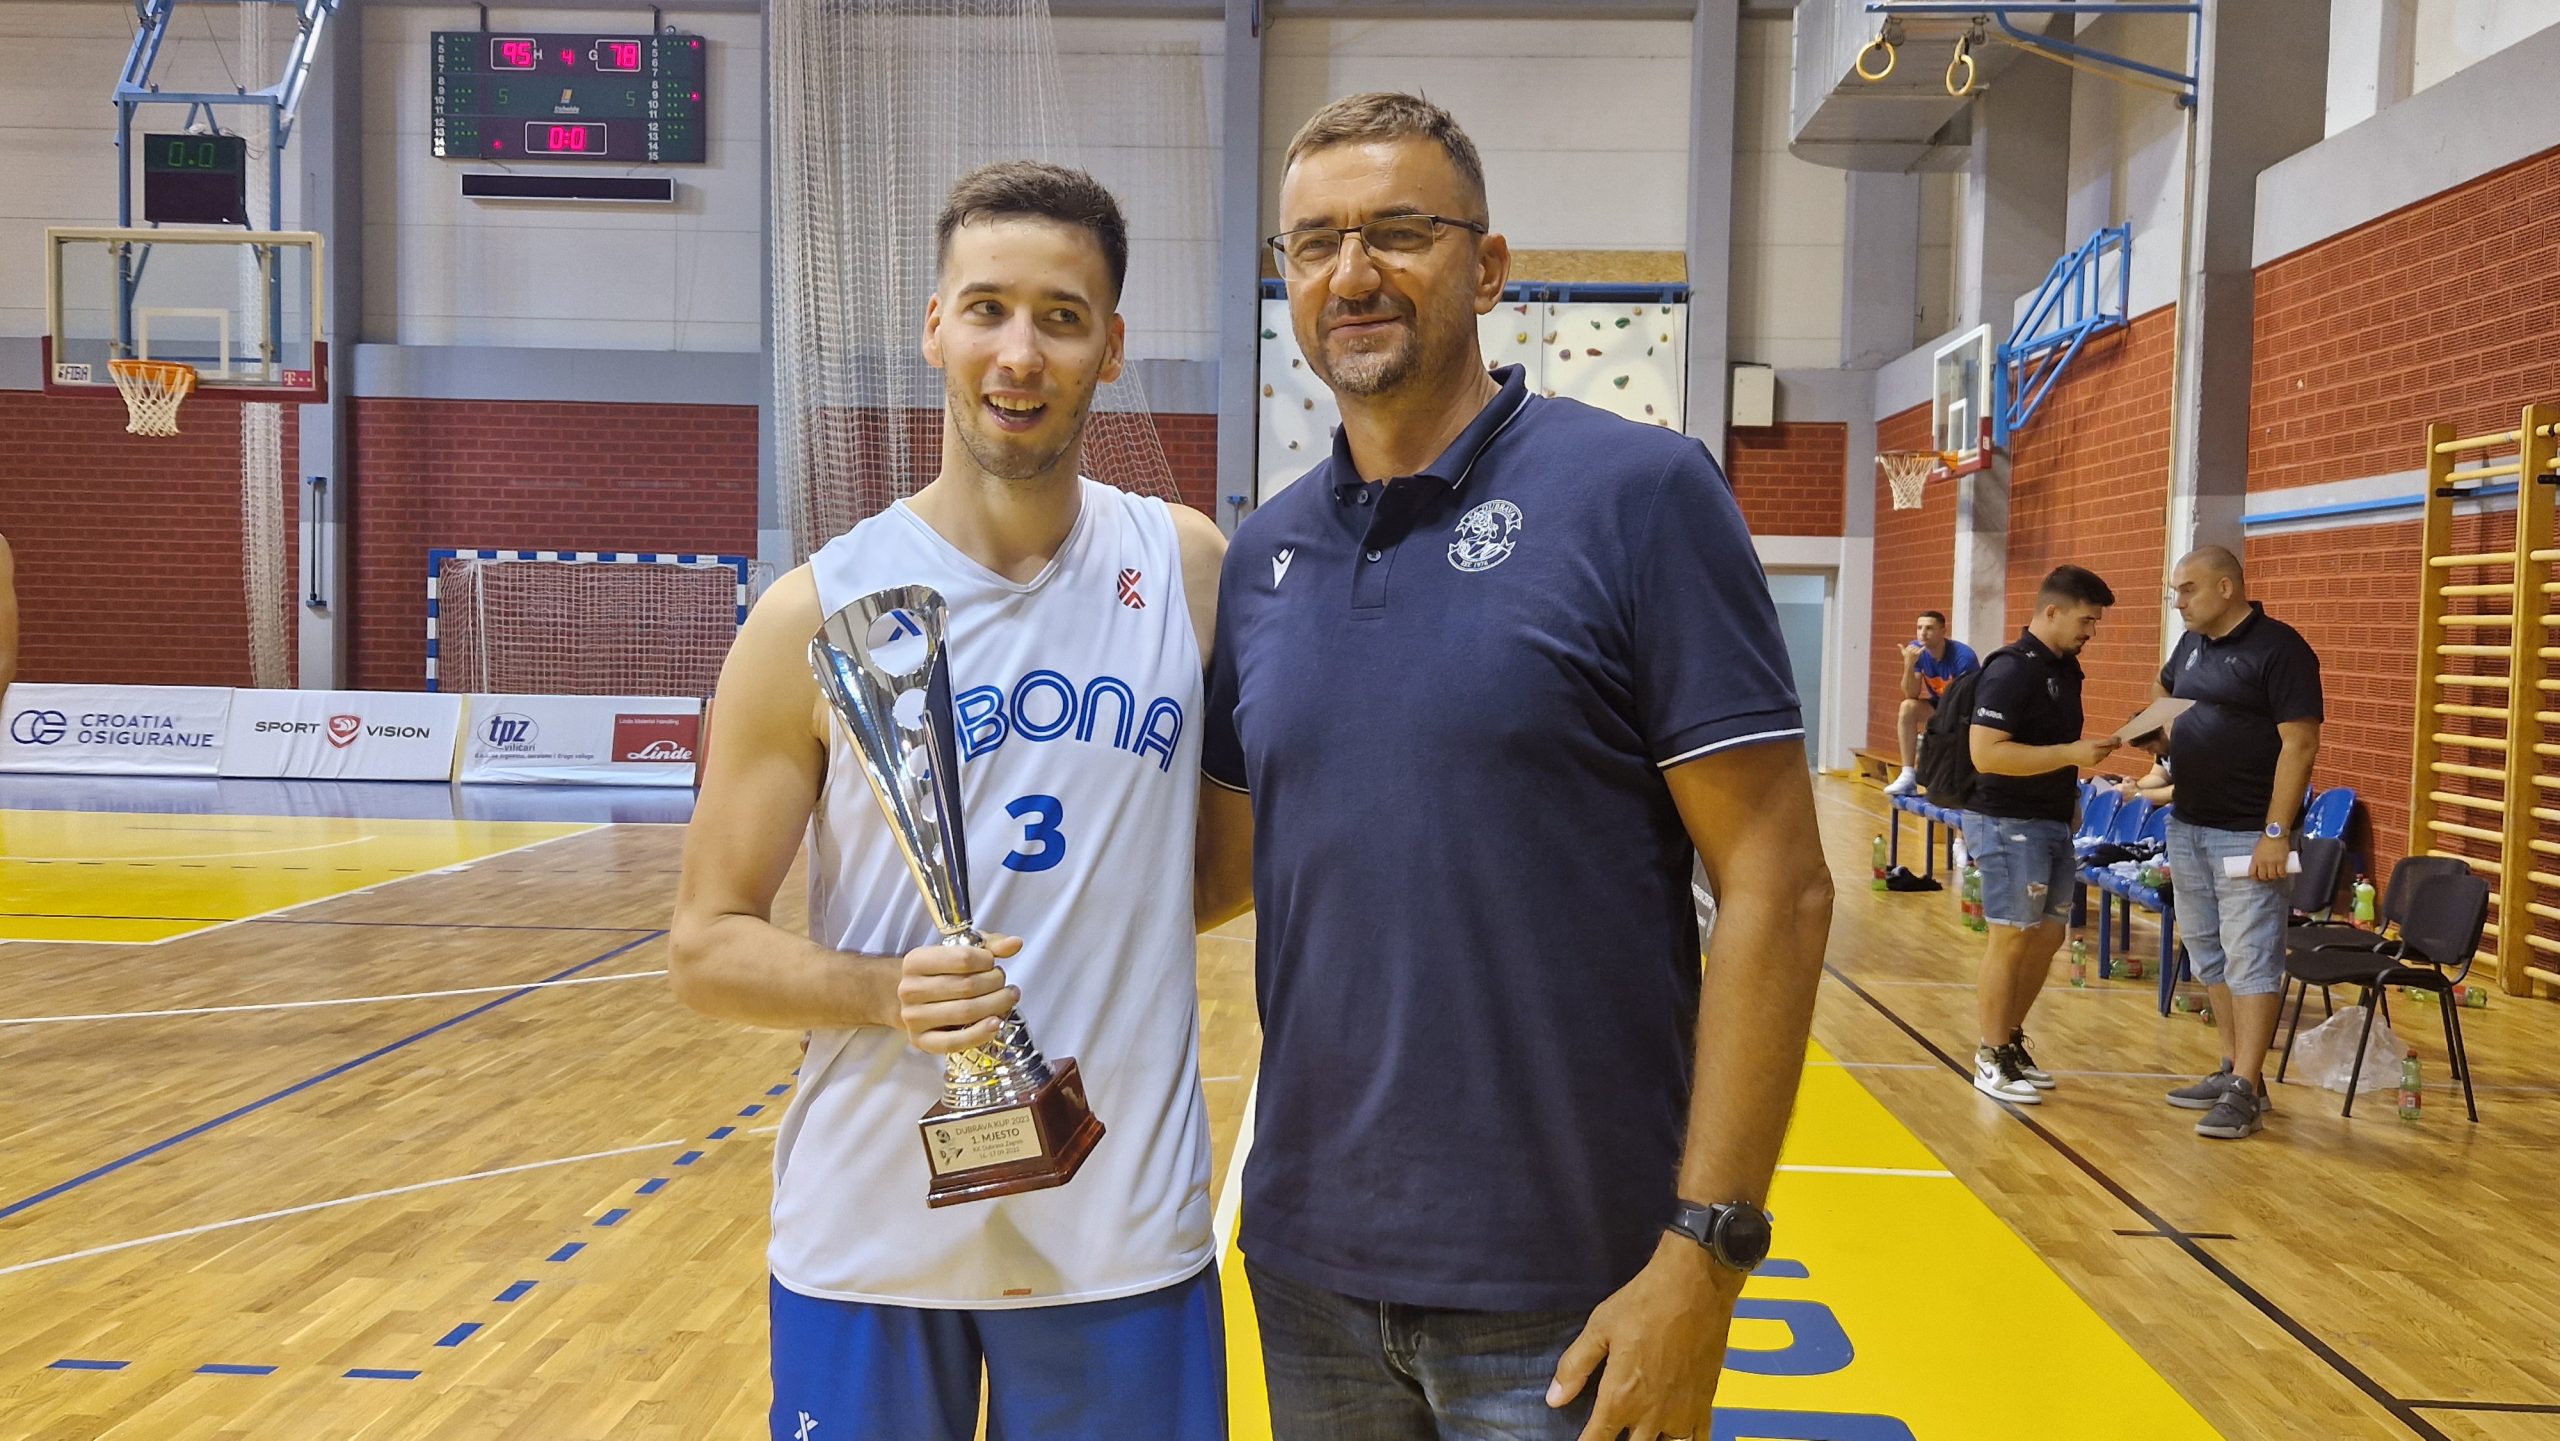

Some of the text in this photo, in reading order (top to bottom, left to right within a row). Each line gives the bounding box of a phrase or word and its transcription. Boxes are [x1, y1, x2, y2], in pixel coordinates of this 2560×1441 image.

[438, 35, 445, 43] 4
[651, 38, 659, 47] 4
[438, 45, 445, 53] 5
[651, 48, 659, 57] 5
[438, 54, 445, 63] 6
[502, 42, 532, 66] 95
[562, 49, 575, 65] 4
[588, 49, 598, 61] G
[609, 43, 637, 68] 78
[651, 58, 659, 67] 6
[438, 64, 445, 73] 7
[651, 68, 659, 77] 7
[438, 76, 445, 85] 8
[651, 80, 659, 90] 8
[438, 86, 445, 95] 9
[651, 90, 659, 99] 9
[434, 96, 445, 105] 10
[648, 100, 659, 109] 10
[434, 106, 445, 114] 11
[648, 110, 659, 119] 11
[434, 117, 445, 127] 12
[648, 122, 659, 131] 12
[434, 128, 445, 136] 13
[648, 132, 659, 141] 13
[548, 126, 587, 151] 0:0
[648, 142, 659, 151] 14
[168, 141, 215, 168] 0.0
[648, 151, 659, 160] 15
[80, 713, 173, 729] CROATIA
[955, 669, 1183, 773] BONA
[254, 721, 430, 738] SPORT VISION
[488, 715, 530, 747] tpz
[77, 730, 214, 747] OSIGURANJE
[626, 740, 693, 760] Linde
[1001, 794, 1066, 873] 3
[955, 1123, 994, 1136] DUBRAVA
[994, 1119, 1010, 1129] KUP
[982, 1128, 1020, 1142] MJESTO
